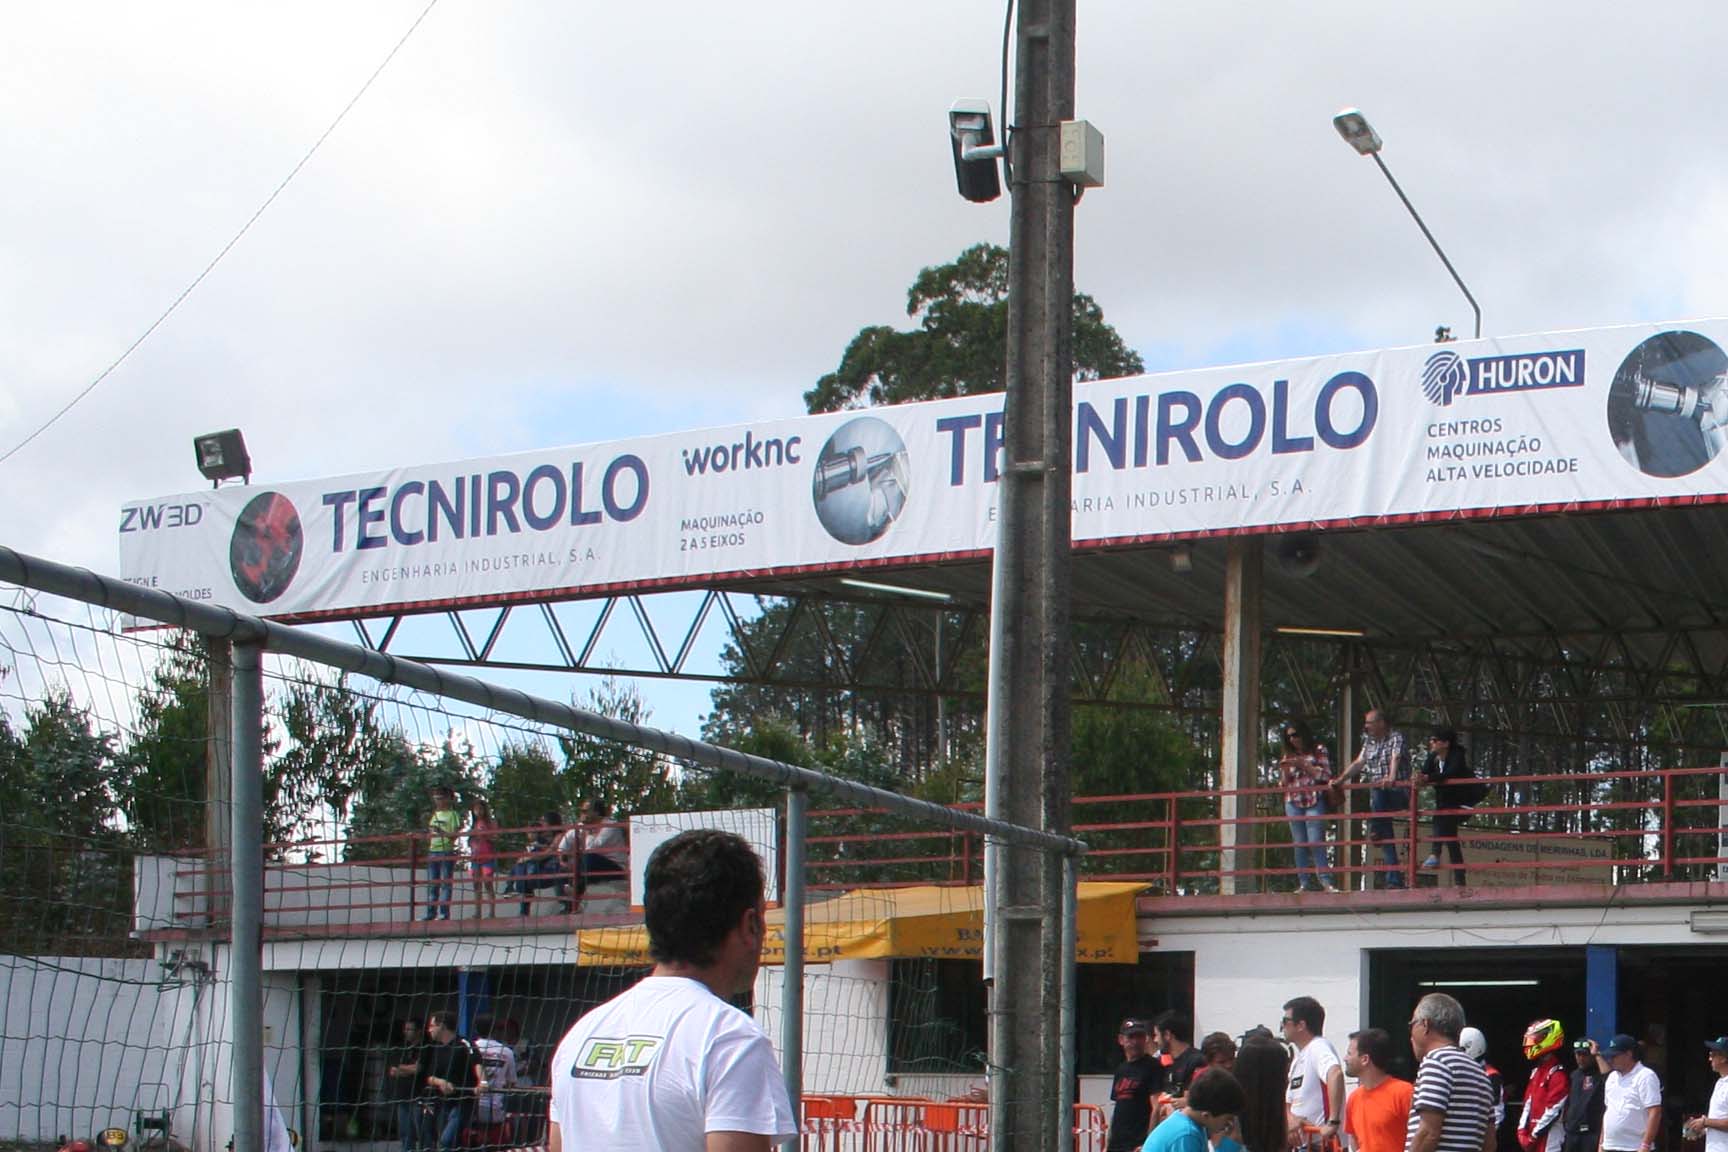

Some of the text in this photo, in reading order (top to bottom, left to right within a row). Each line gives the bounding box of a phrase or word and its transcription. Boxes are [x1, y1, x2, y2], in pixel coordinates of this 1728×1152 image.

[1477, 355, 1576, 390] HURON
[936, 370, 1379, 487] TENIROLO
[1427, 418, 1502, 438] CENTROS
[682, 431, 801, 476] worknc
[1426, 435, 1541, 460] MAQUINAÇÃO
[1426, 458, 1578, 482] ALTA VELOCIDADE
[322, 455, 649, 553] TECNIROLO
[680, 509, 764, 531] MAQUINAÇÃO
[681, 533, 745, 551] 2 A 5 EIXOS
[362, 562, 457, 583] ENGENHARIA
